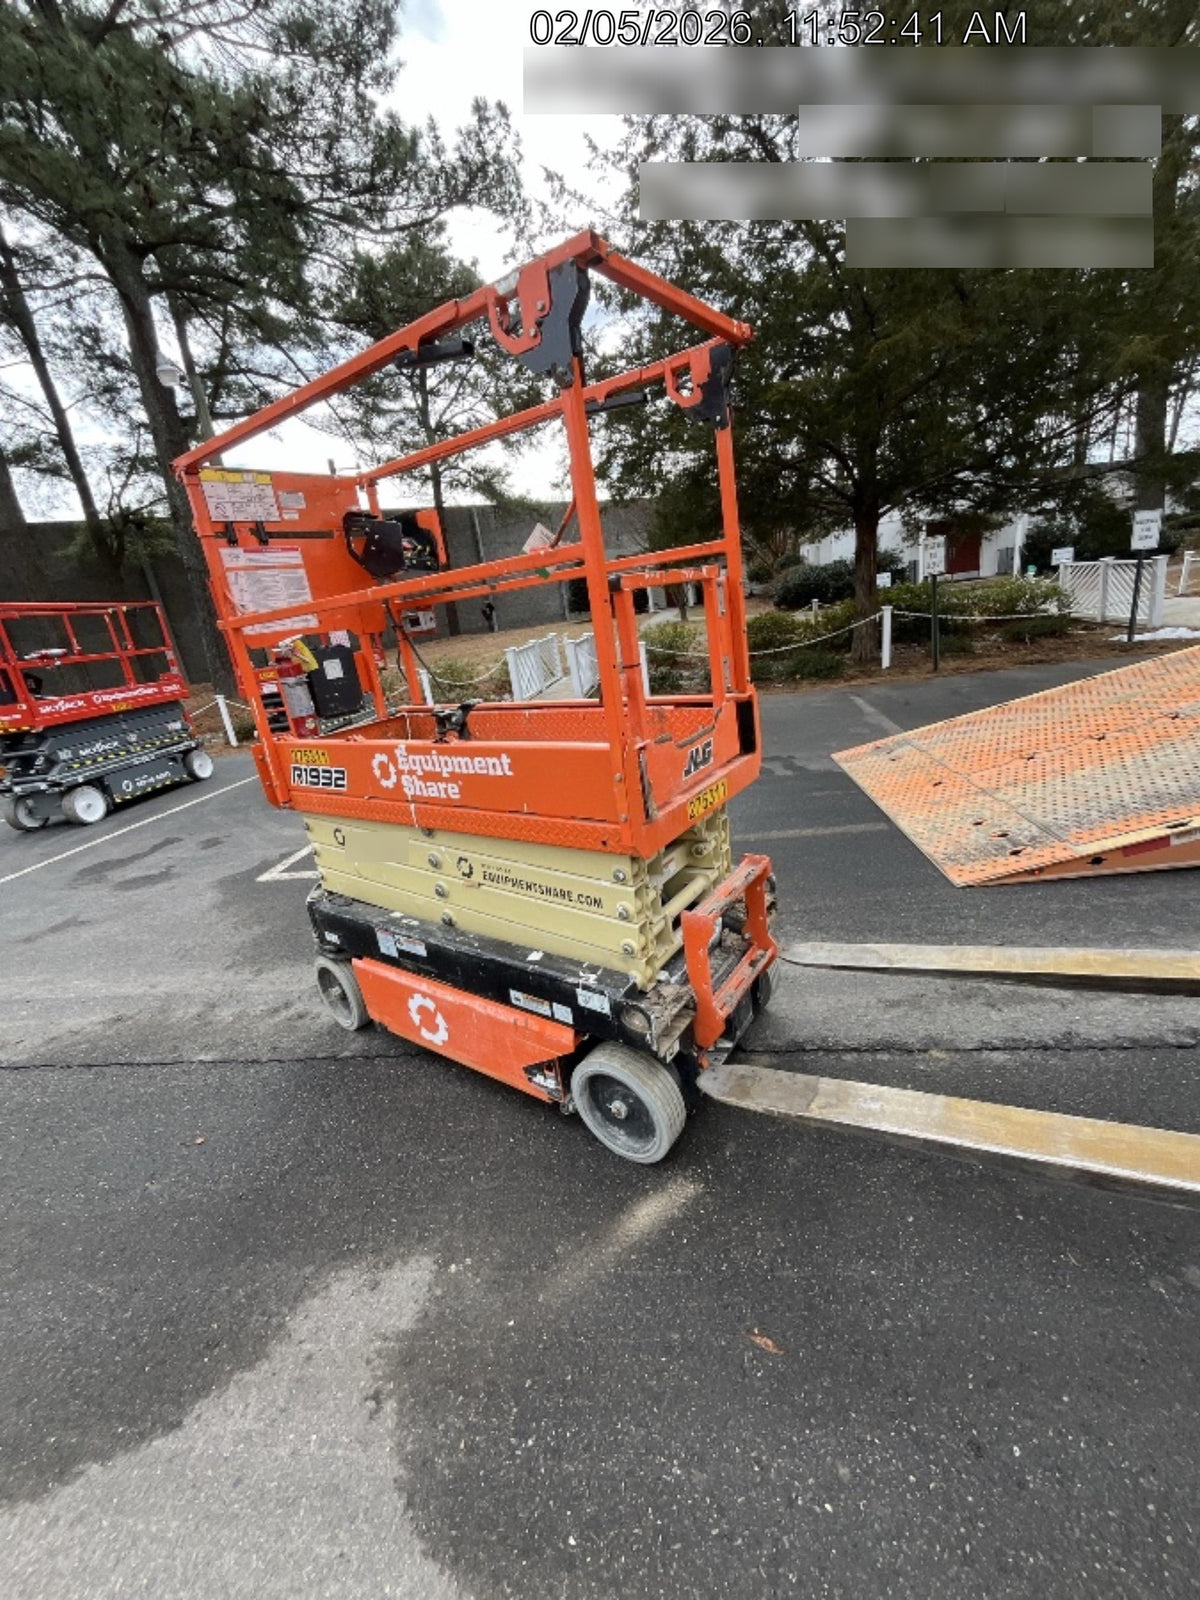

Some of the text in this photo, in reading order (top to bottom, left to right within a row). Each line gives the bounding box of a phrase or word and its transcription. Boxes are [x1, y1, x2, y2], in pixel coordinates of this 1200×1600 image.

[396, 748, 514, 778] Equipment
[292, 766, 346, 788] R1932
[401, 775, 462, 799] Share
